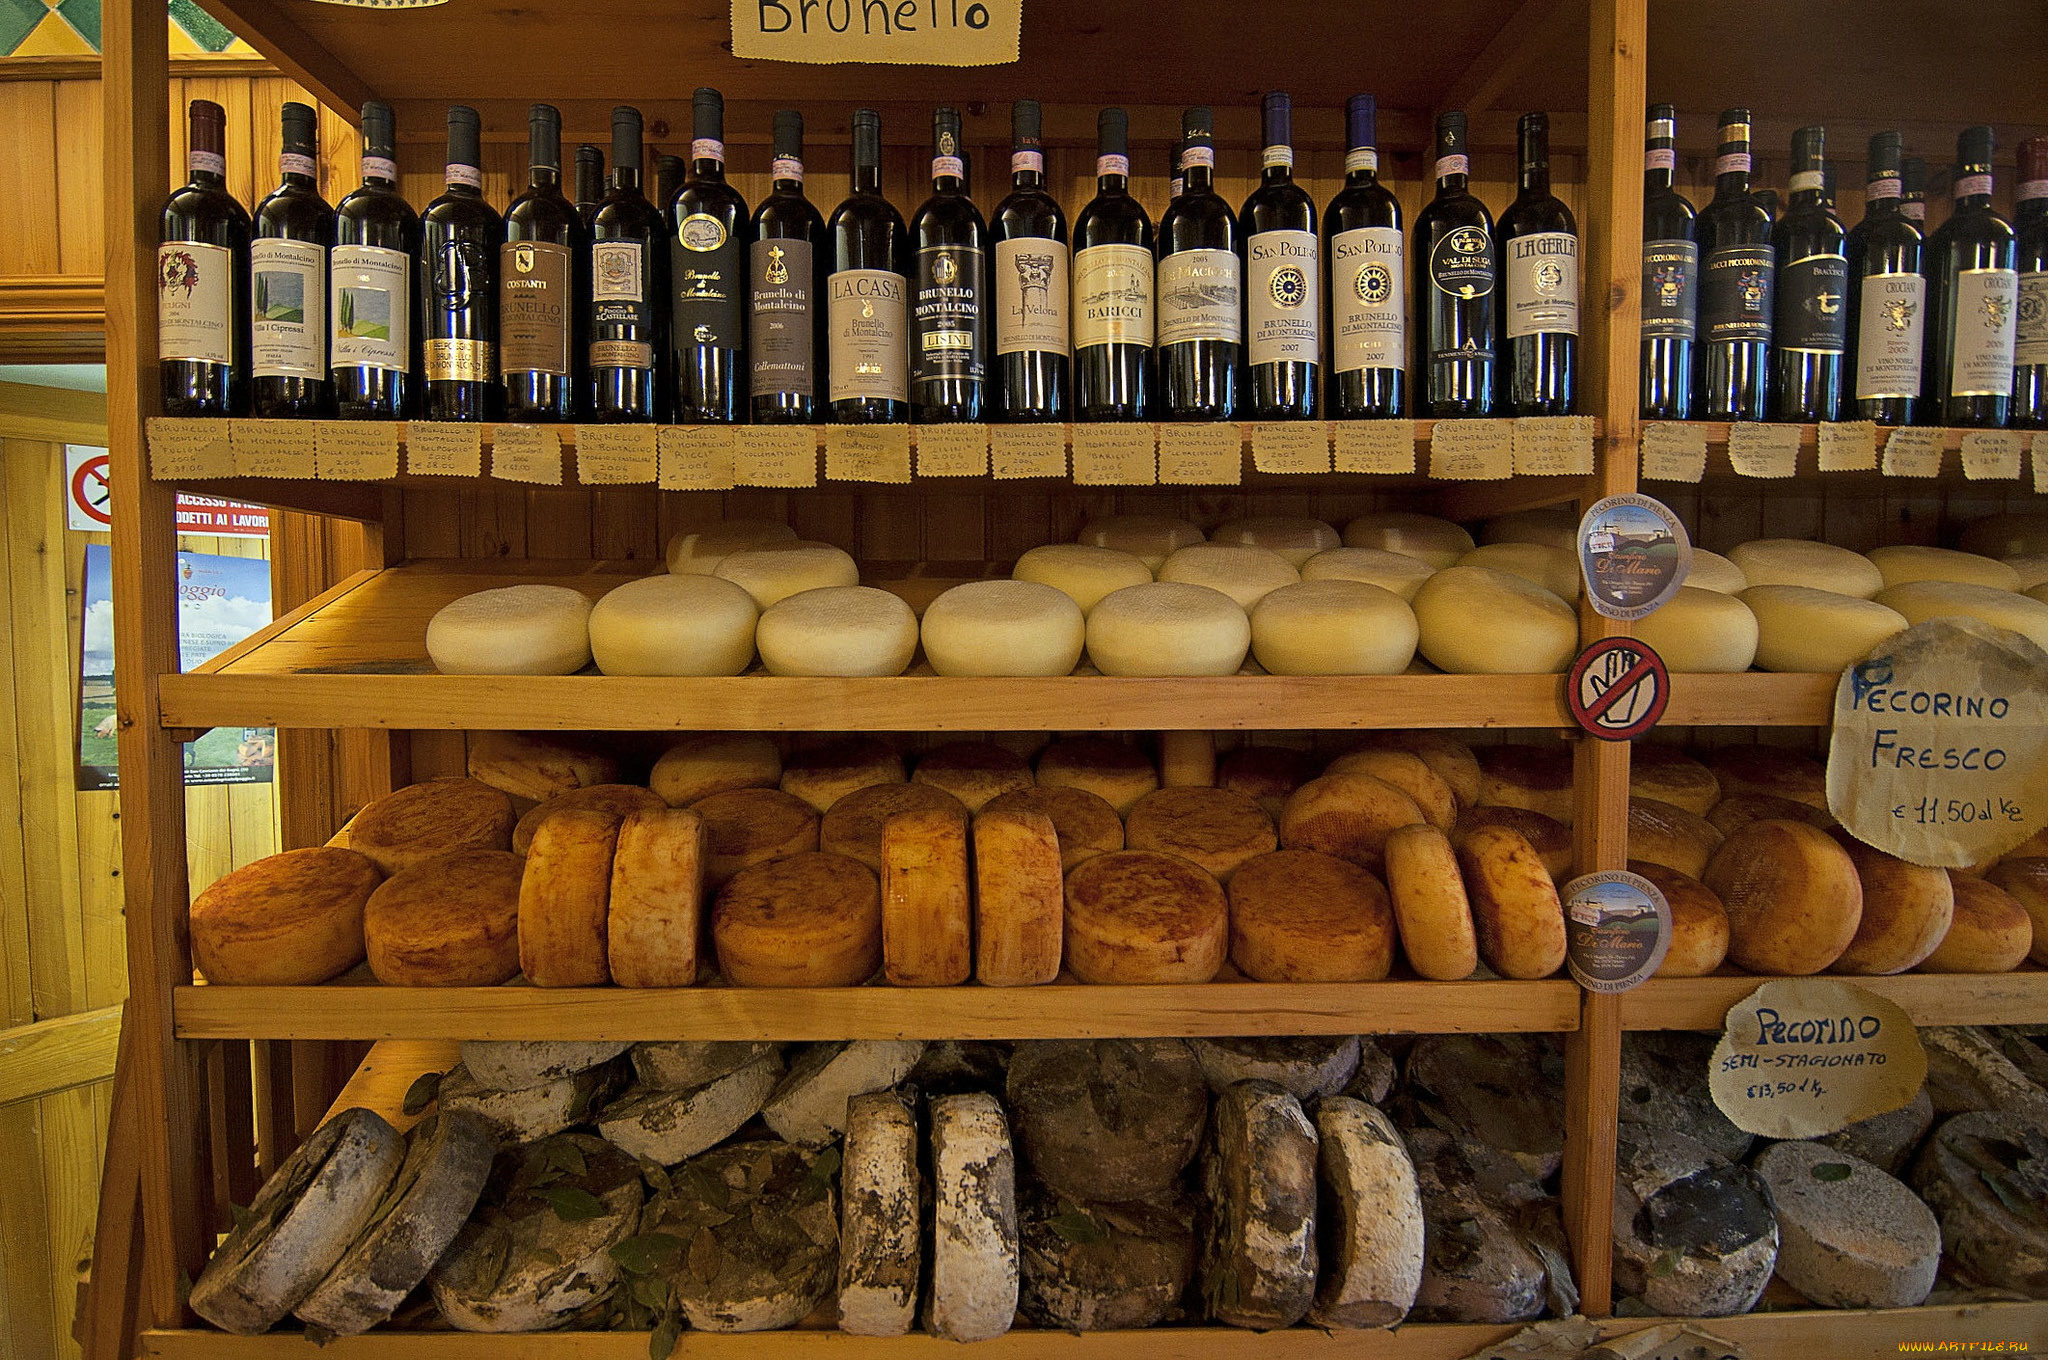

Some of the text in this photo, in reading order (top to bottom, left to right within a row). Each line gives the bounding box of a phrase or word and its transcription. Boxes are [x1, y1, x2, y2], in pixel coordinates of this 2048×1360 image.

[758, 0, 990, 35] Brunello
[1252, 241, 1317, 261] SAN POLINO
[1336, 239, 1402, 260] SAN POLINO
[1515, 237, 1576, 259] LA GERLA
[274, 252, 315, 264] Montalcino
[1442, 256, 1491, 265] VAL DI SUGA
[354, 258, 404, 271] di Montalcino
[684, 270, 722, 281] Brunello
[507, 280, 548, 290] COSTANTI
[834, 278, 901, 300] LA CASA
[680, 289, 727, 300] Montalcino
[753, 289, 806, 301] Brunello di
[919, 287, 974, 300] BRUNELLO
[753, 301, 806, 312] Montalcino
[915, 302, 980, 316] MONTALCINO
[1516, 299, 1541, 309] Brunello
[603, 308, 627, 316] POGGIO
[1012, 305, 1058, 317] La Velona
[1087, 306, 1142, 319] BARICCI
[174, 318, 224, 329] MONTALCINO
[1348, 312, 1398, 324] BRUNELLO
[271, 324, 305, 334] Cipressi
[852, 318, 885, 330] Brunello
[937, 320, 956, 328] 2005
[1264, 319, 1312, 330] BRUNELLO
[1341, 322, 1402, 334] DI MONTALCINO
[843, 327, 894, 339] di Montalcino
[1257, 327, 1316, 338] DI MONTALCINO
[927, 335, 969, 347] LISINI
[361, 346, 397, 358] Cipressi
[597, 344, 638, 353] BRUNELLO
[1281, 343, 1299, 352] 2007
[1887, 346, 1909, 354] 2008
[604, 351, 640, 359] MONTALCINO
[1366, 353, 1385, 361] 2007
[753, 362, 806, 373] Collemattoni
[154, 423, 217, 434] BRUNELLO
[237, 425, 303, 436] BRUNELLO
[319, 427, 382, 437] BRUNELLO
[413, 424, 461, 435] BRUNELLO
[920, 427, 984, 437] BRUNELLO DI
[1076, 428, 1147, 437] BRUNELLO DI
[1257, 425, 1304, 433] BRUNELLO
[1436, 423, 1496, 433] BRUNELLO
[1518, 422, 1591, 433] BRUNELLO DI
[579, 430, 642, 442] BRUNELLO
[662, 431, 718, 440] BRUNELLO
[739, 431, 790, 439] BRUNELLO
[996, 430, 1044, 440] BRUNELLO
[1166, 428, 1224, 439] BRUNELLO
[1436, 434, 1508, 443] DI MONTALCINO
[250, 437, 310, 446] MONTALCINO
[337, 439, 393, 447] MONTALCINO
[414, 435, 475, 444] MONTALCINO
[678, 441, 731, 449] MONTALCINO
[744, 440, 807, 449] MONTALCINO
[921, 436, 979, 444] MONTALCINO
[1005, 440, 1058, 448] MONTALCINO
[1085, 440, 1145, 449] MONTALCINO
[1178, 440, 1235, 448] MONTALCINO
[1522, 435, 1588, 444] MONTALCINO
[598, 443, 652, 454] MONTALCINO
[1590, 496, 1677, 529] PECORINO DI PIENZA
[176, 510, 269, 528] DDETTI AI LAVORI
[179, 584, 226, 601] oggio
[1851, 655, 2010, 720] PECORINO
[1871, 728, 2007, 771] FRESCO
[1891, 804, 1907, 819] €
[1914, 796, 1976, 825] 11.50
[1570, 873, 1619, 893] PECORINO
[1619, 874, 1631, 885] DI
[1604, 973, 1644, 992] DI PIENZA
[1756, 1007, 1881, 1046] Pecorino
